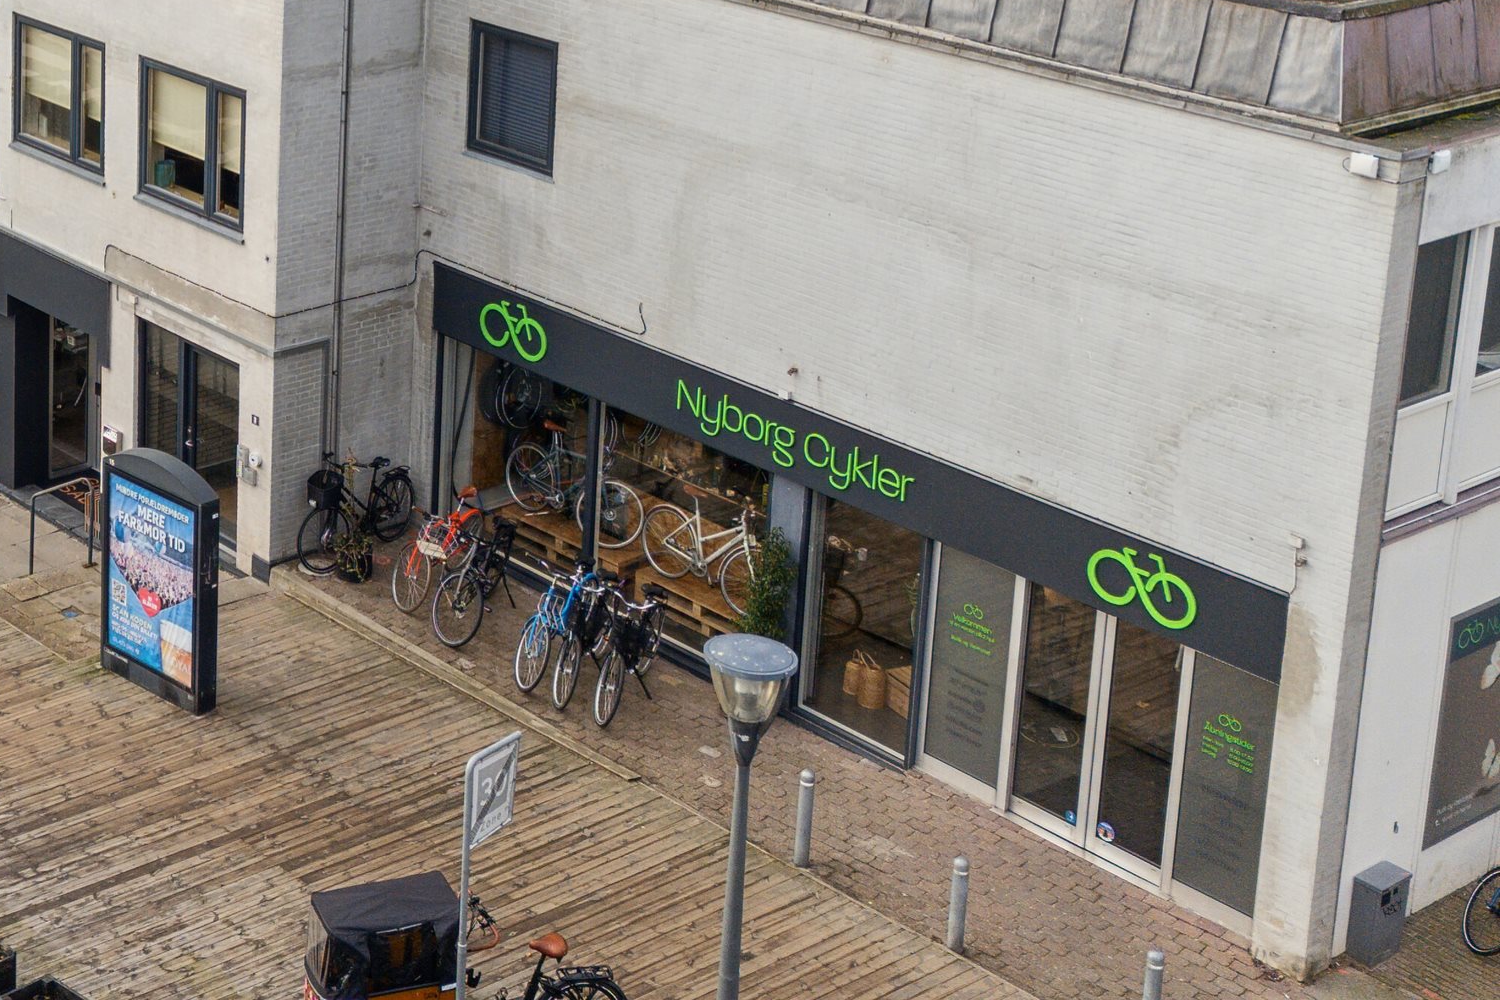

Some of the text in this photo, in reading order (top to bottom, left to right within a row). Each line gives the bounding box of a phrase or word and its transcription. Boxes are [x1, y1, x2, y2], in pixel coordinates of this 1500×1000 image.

[677, 379, 916, 502] Nyborg Cykler
[115, 482, 139, 501] MINDRE
[118, 510, 186, 554] FAR&MOR TID
[137, 504, 166, 530] MERE
[111, 603, 129, 619] SCAN
[480, 769, 508, 807] 30
